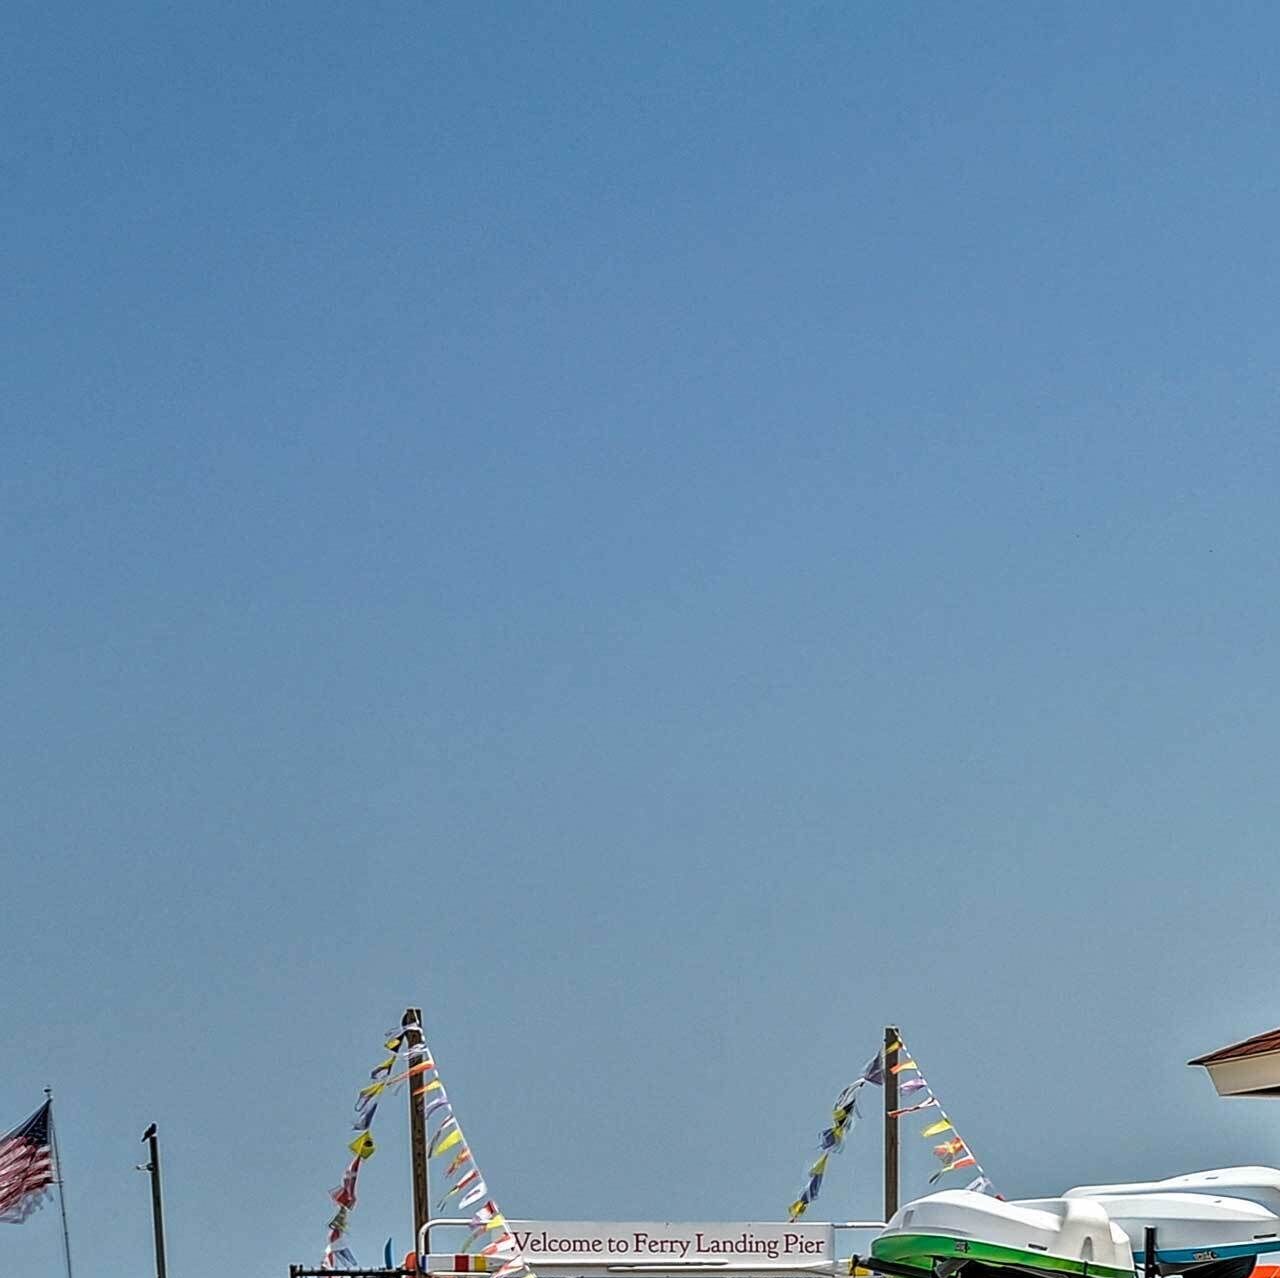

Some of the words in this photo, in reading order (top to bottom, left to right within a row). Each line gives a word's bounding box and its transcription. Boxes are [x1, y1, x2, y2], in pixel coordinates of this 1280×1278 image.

[608, 1238, 629, 1253] to
[633, 1233, 690, 1257] Ferry
[695, 1233, 779, 1259] Landing
[784, 1234, 825, 1254] Pier
